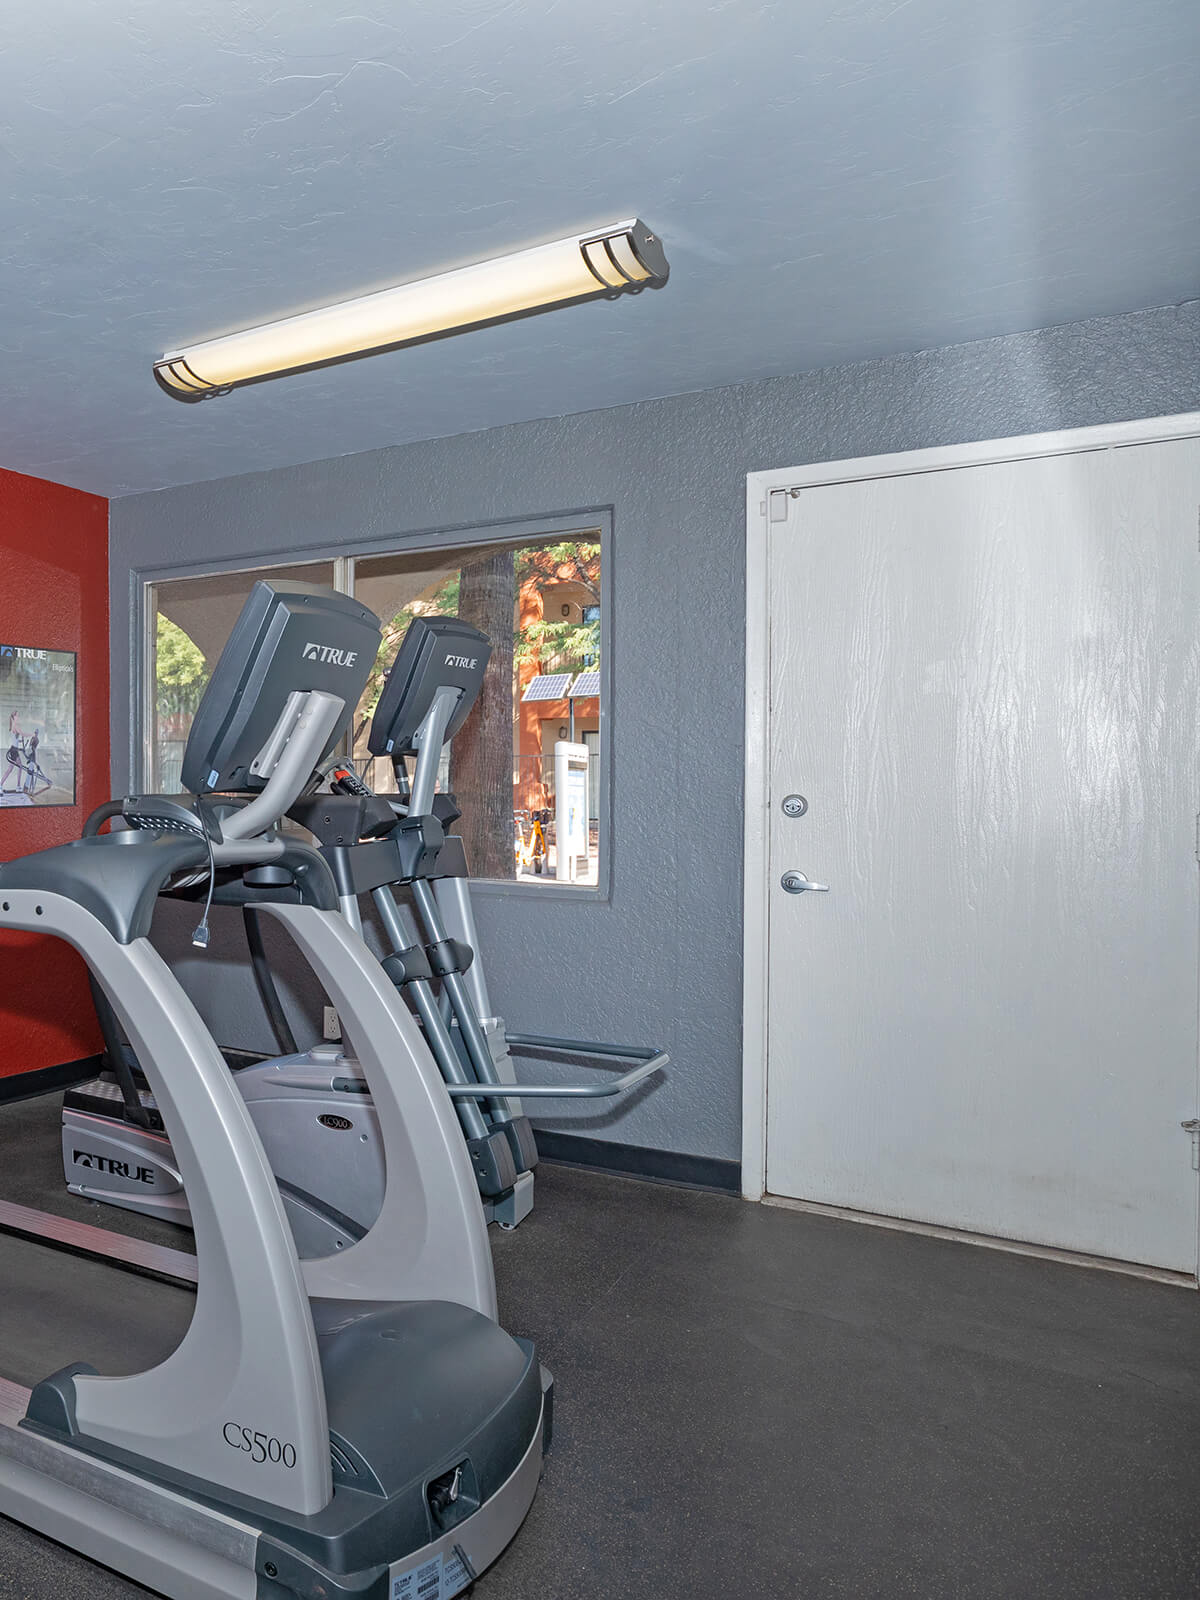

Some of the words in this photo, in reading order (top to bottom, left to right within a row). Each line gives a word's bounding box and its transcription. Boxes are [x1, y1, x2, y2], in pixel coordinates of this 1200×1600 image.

[14, 647, 48, 660] TRUE
[319, 645, 359, 668] TRUE
[453, 656, 478, 670] TRUE
[92, 1155, 155, 1185] TRUE
[222, 1421, 297, 1469] CS500
